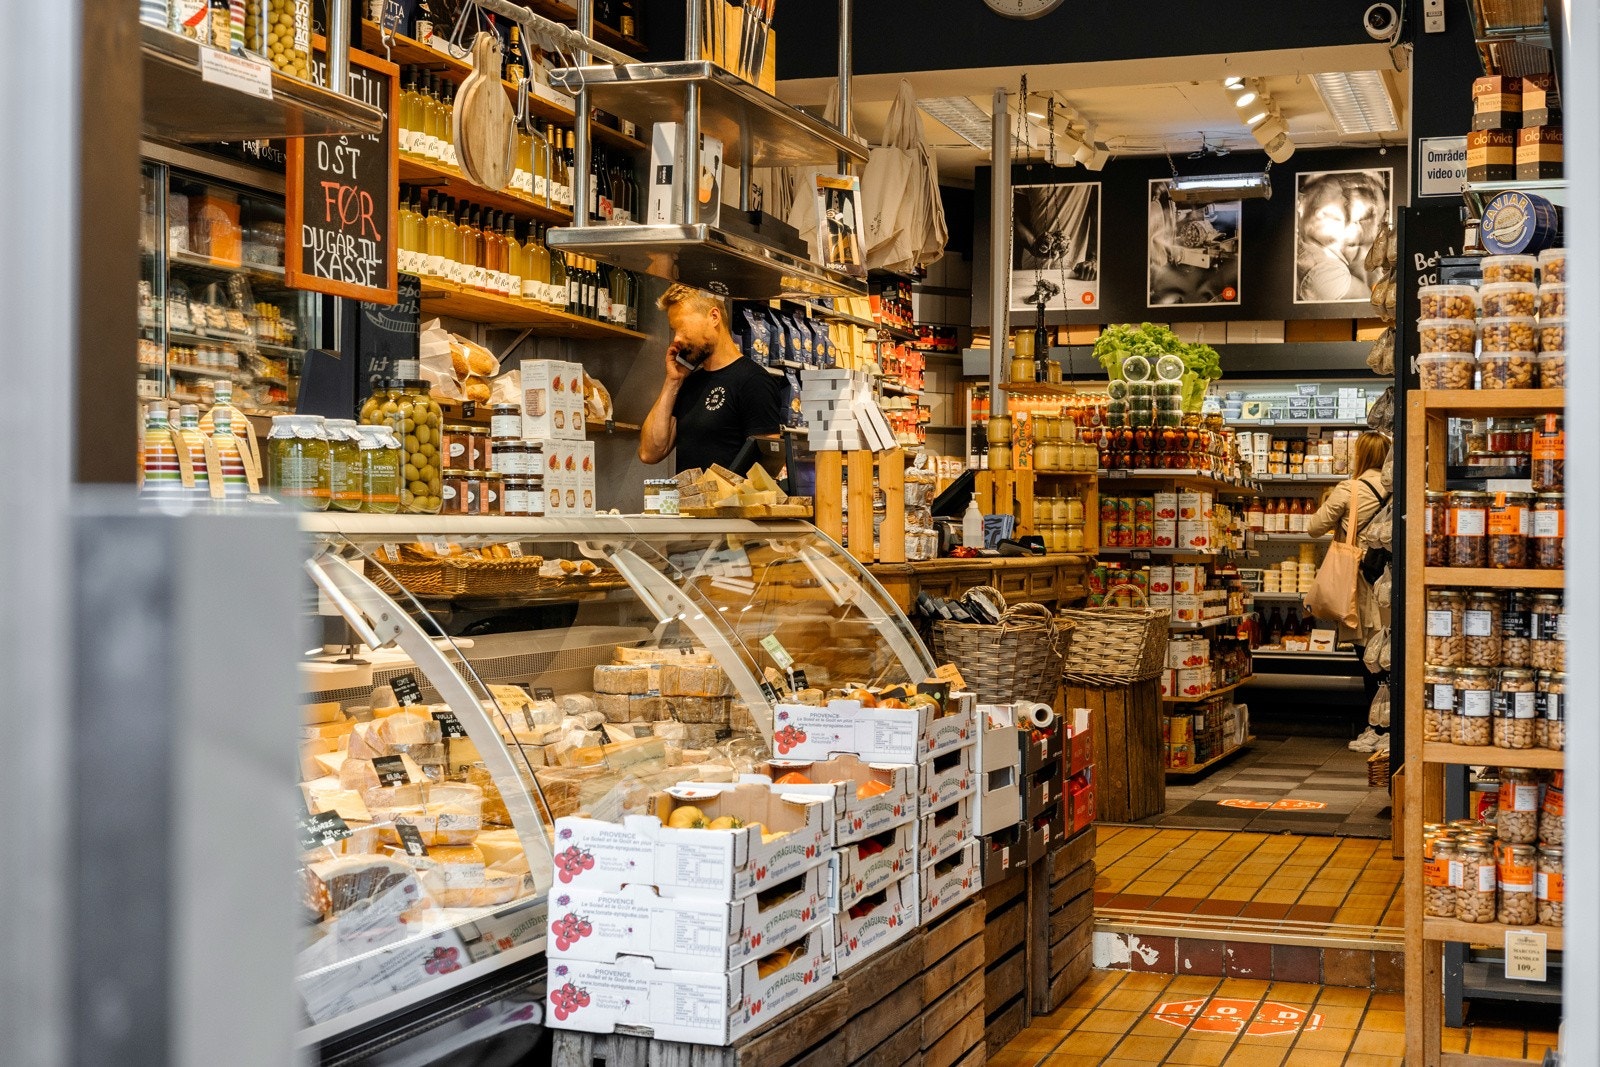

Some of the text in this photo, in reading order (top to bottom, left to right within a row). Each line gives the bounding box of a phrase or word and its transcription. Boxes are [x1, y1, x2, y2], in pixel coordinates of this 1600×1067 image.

[1427, 149, 1467, 163] Området
[1427, 167, 1453, 180] video
[321, 181, 381, 241] FØR
[1482, 193, 1529, 232] CAVIAR
[302, 224, 383, 264] DU GÅR TIL
[313, 249, 378, 288] KASSE
[1017, 418, 1028, 468] VEGAN
[600, 831, 636, 839] PROVENCE
[598, 897, 634, 905] PROVENCE
[595, 968, 631, 978] PROVENCE
[1183, 1004, 1299, 1020] HOD
